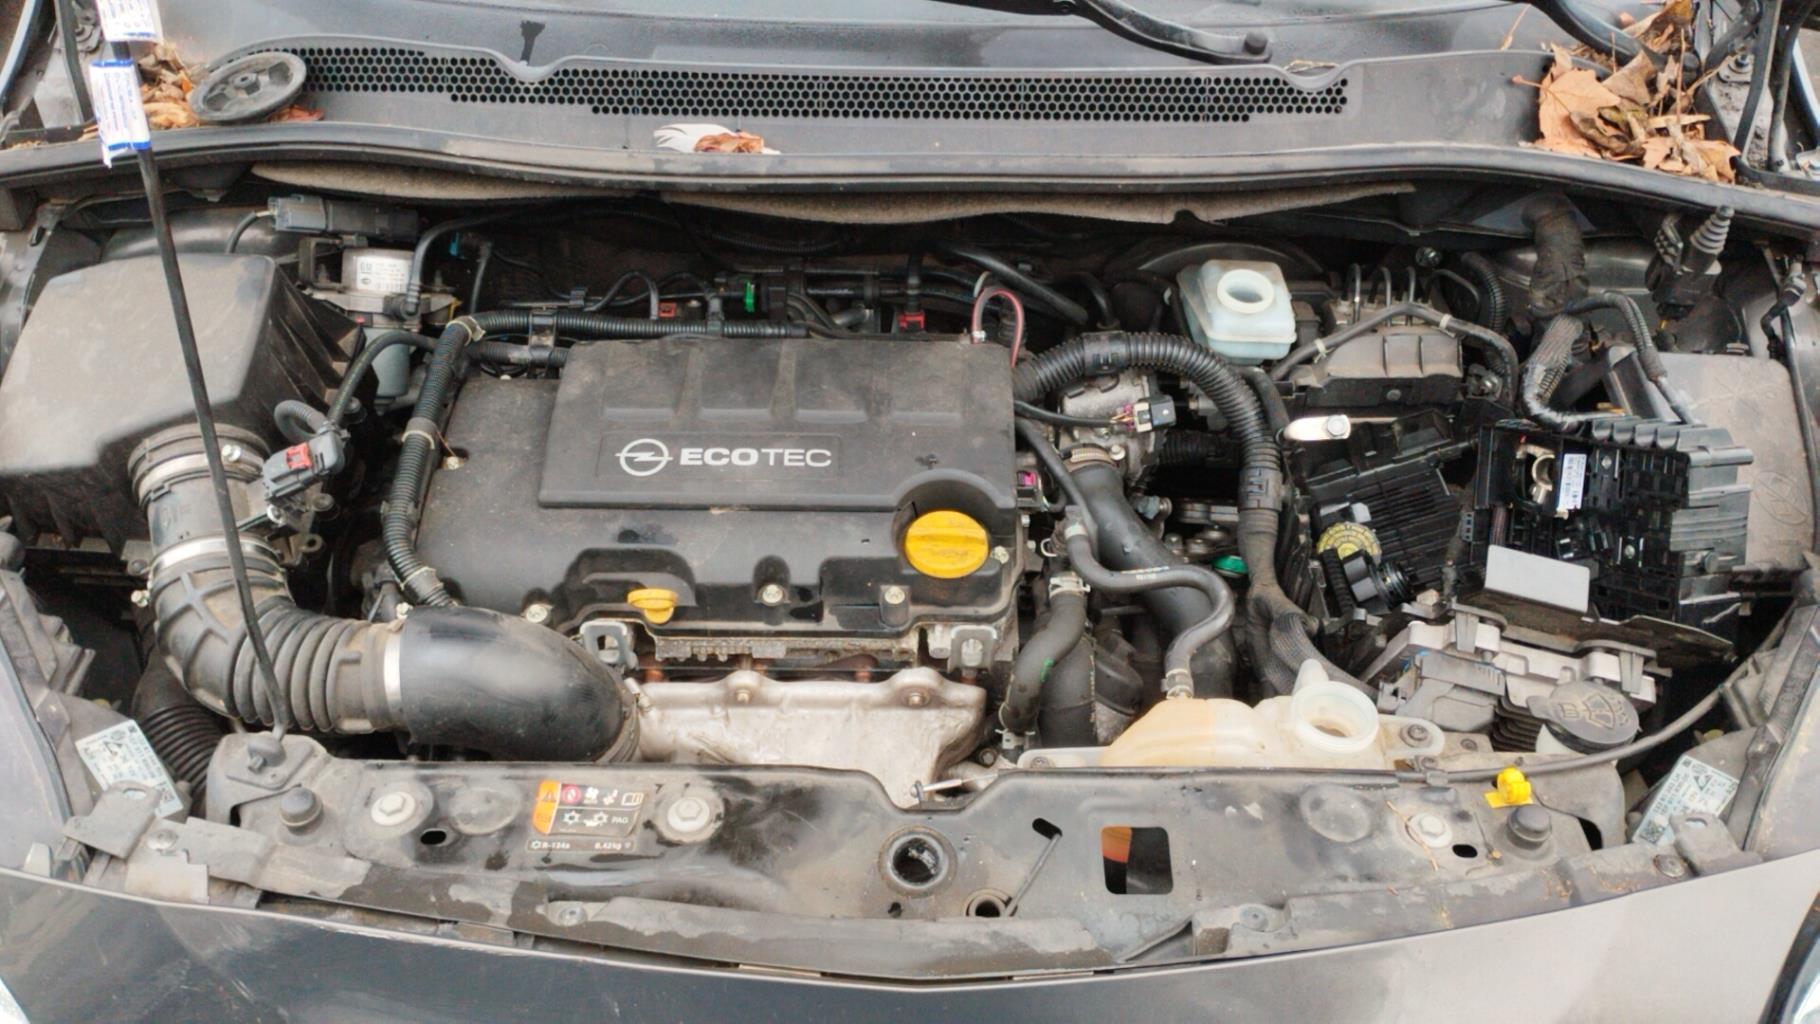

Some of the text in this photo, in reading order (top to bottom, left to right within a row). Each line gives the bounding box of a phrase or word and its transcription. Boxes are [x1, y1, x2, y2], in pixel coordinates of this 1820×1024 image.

[679, 447, 833, 468] ECOTEC
[611, 815, 629, 824] PAG
[541, 841, 571, 850] R-134a
